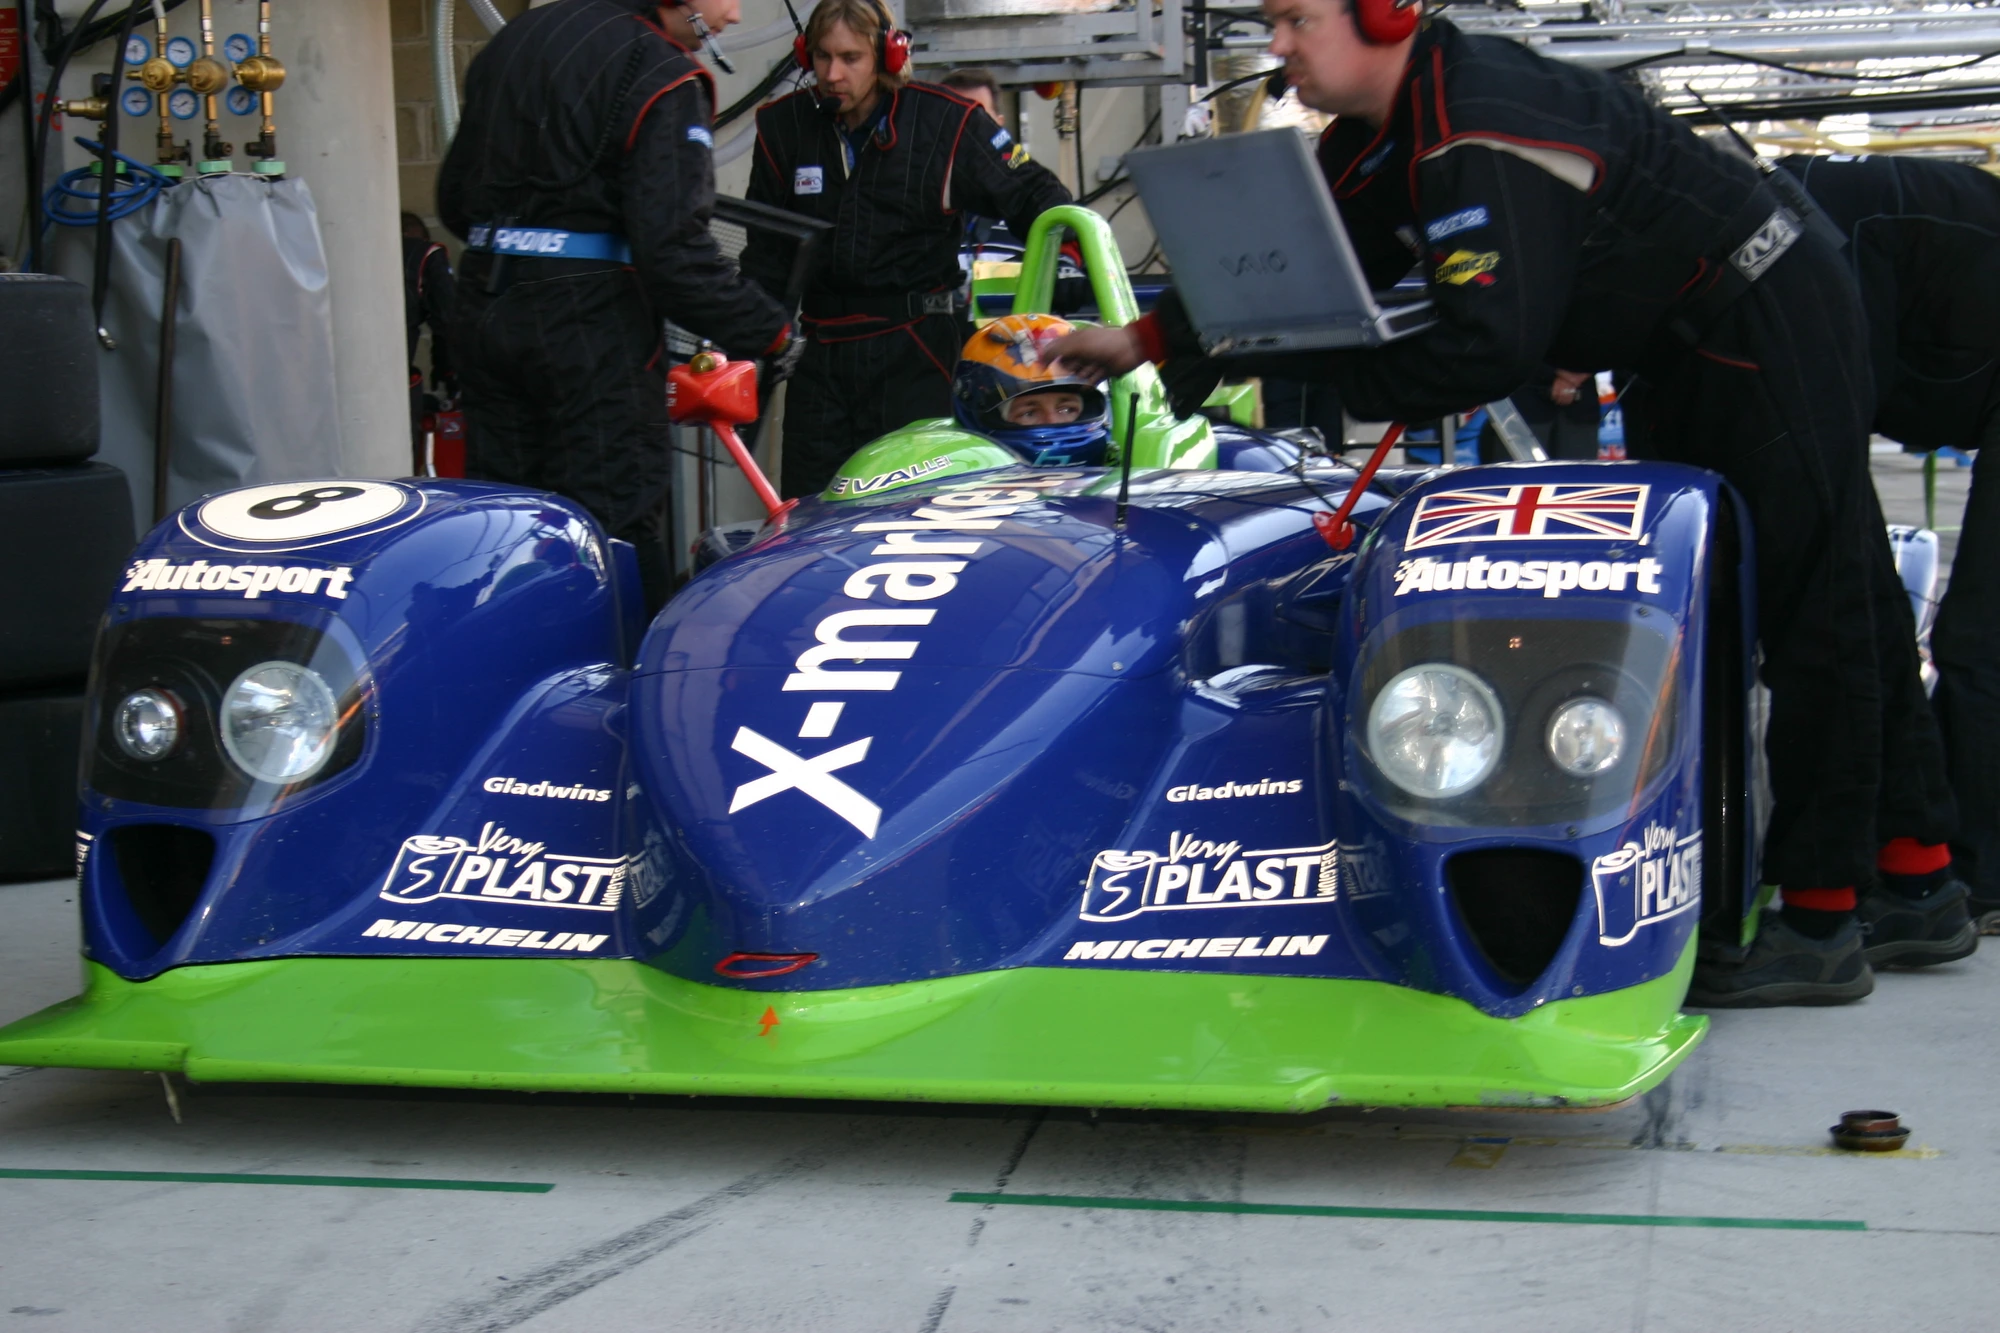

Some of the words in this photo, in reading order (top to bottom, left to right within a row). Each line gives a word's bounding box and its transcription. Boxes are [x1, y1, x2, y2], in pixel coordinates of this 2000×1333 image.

[1217, 249, 1289, 277] VAIO
[247, 486, 366, 520] 8
[121, 558, 354, 600] Autosport
[1394, 555, 1662, 599] Autosport
[483, 777, 612, 802] Gladwins
[1166, 778, 1303, 803] Gladwins
[476, 821, 547, 868] Very
[1169, 830, 1242, 871] Very
[1644, 819, 1678, 867] Very
[450, 855, 623, 904] PLAST
[1154, 855, 1322, 905] PLAST
[1316, 848, 1338, 898] BELGIUM
[362, 918, 610, 953] MICHELIN
[1063, 934, 1331, 961] MICHELIN
